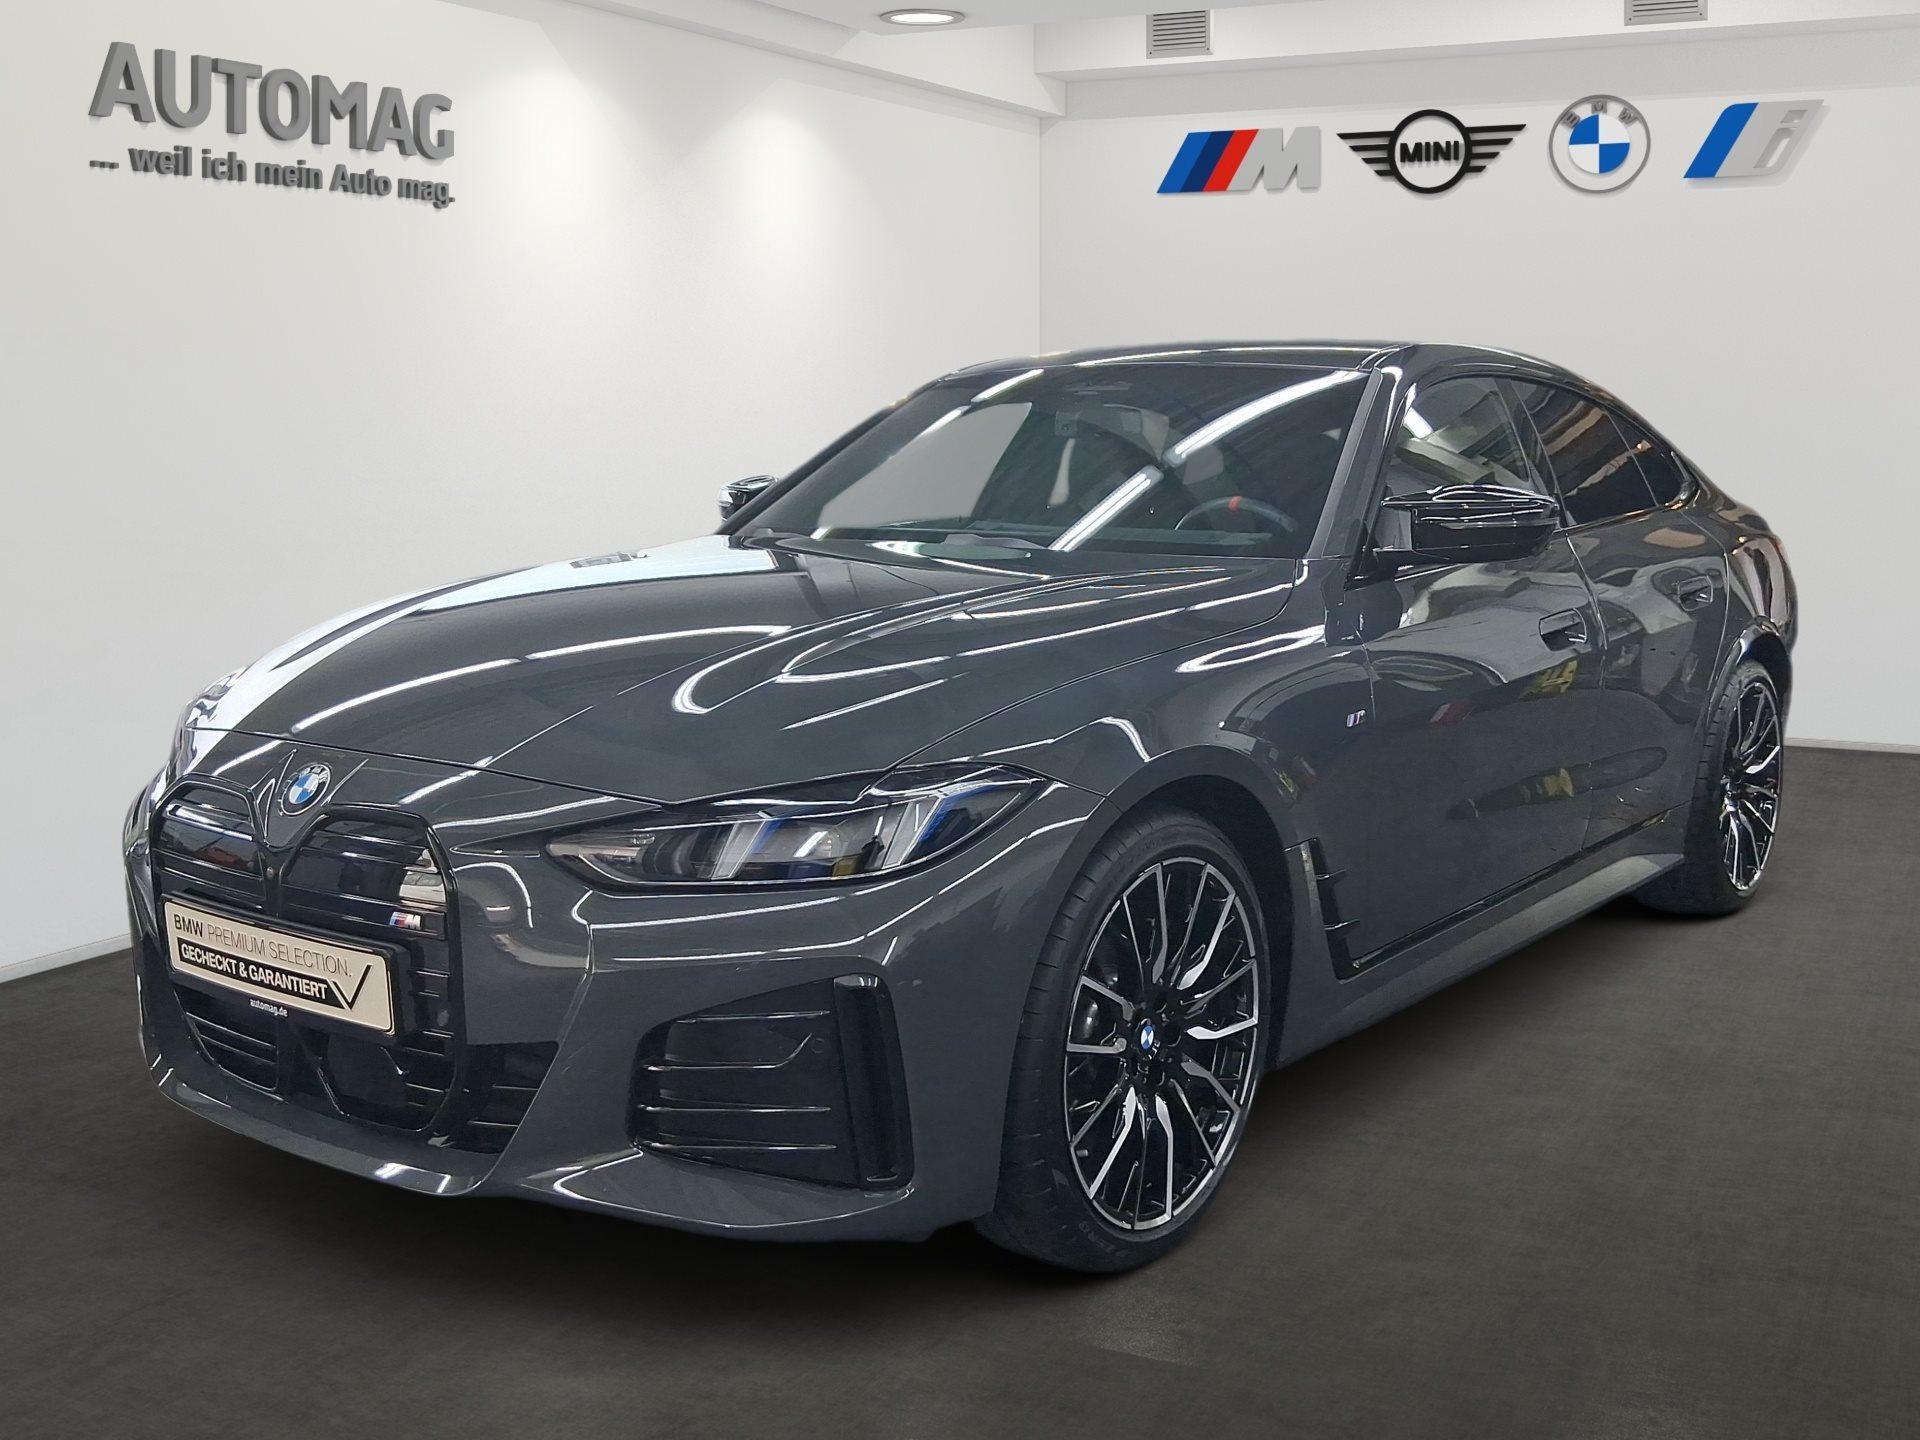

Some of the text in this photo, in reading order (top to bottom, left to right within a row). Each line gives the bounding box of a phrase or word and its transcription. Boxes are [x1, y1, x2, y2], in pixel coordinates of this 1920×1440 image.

[88, 41, 455, 160] AUTOMAG
[1399, 140, 1460, 163] MINI
[128, 145, 193, 177] weil
[201, 148, 247, 182] ich
[255, 159, 323, 190] mein
[329, 164, 392, 197] Auto
[398, 177, 456, 209] mag.
[174, 914, 204, 938] BMW
[207, 923, 268, 956] PREMIUM
[180, 943, 328, 1000] GECHECKT & GARANTIERT
[250, 999, 288, 1017] automag.de
